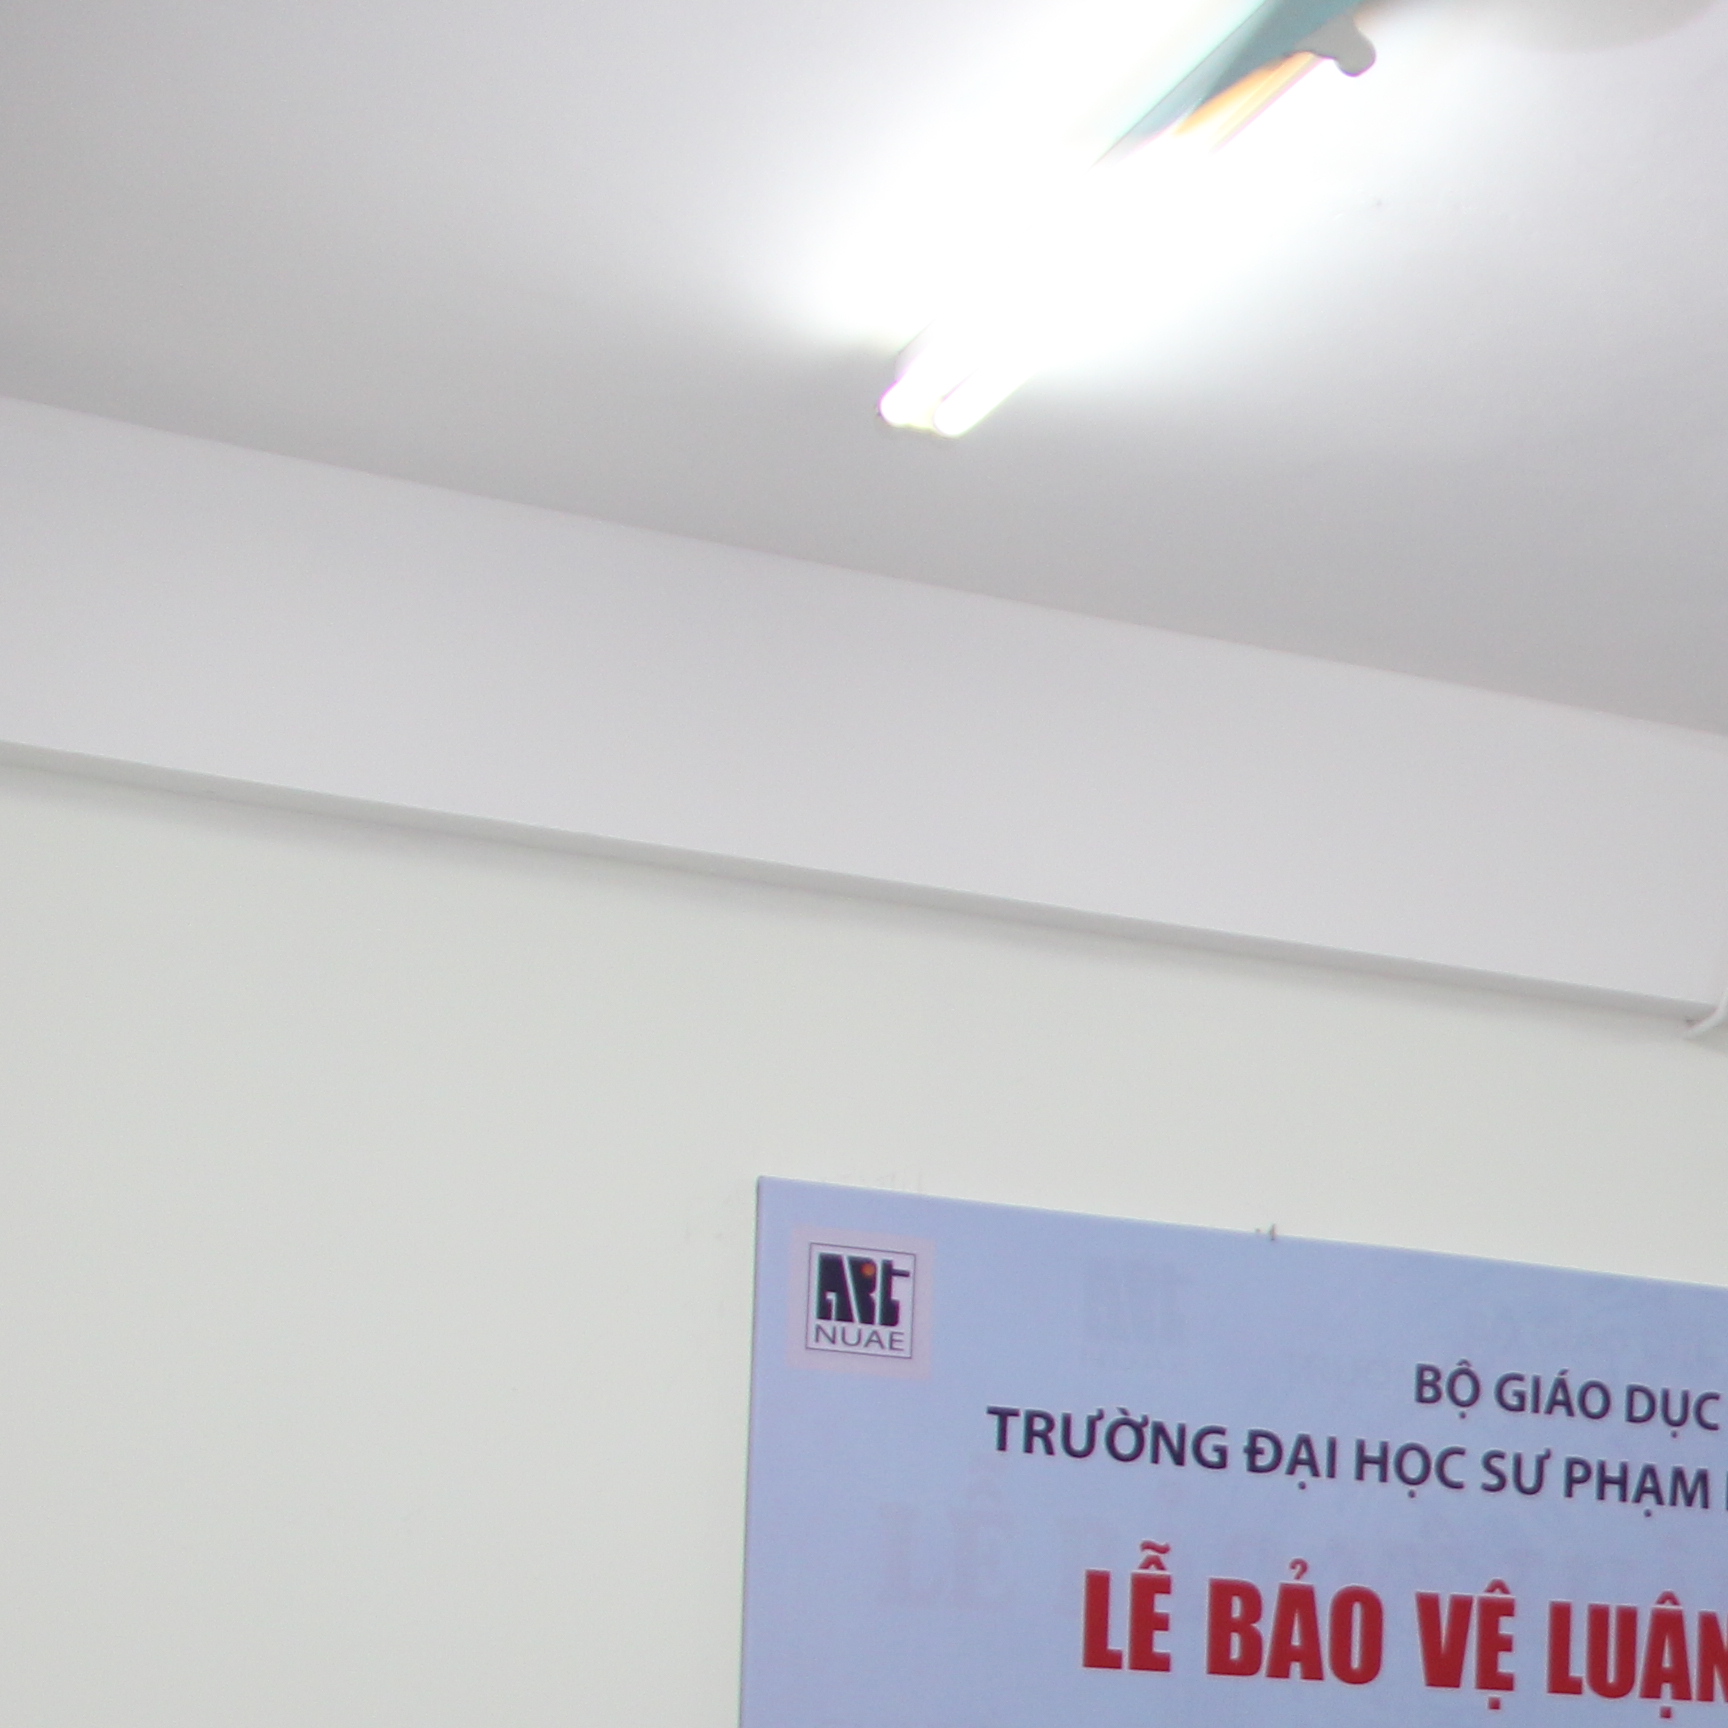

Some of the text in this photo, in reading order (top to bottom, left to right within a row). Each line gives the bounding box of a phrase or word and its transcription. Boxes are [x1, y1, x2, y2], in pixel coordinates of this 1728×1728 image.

[814, 1323, 905, 1352] NUAE
[1414, 1359, 1482, 1419] BỘ
[1495, 1370, 1611, 1420] GIÁO
[1626, 1385, 1720, 1438] DỤC
[987, 1407, 1228, 1470] TRƯỜNG
[1244, 1430, 1336, 1489] ĐẠI
[1355, 1440, 1465, 1498] HỌC
[1482, 1449, 1551, 1496] SƯ
[1565, 1458, 1709, 1517] PHẠM
[1083, 1540, 1173, 1673] LỄ
[1207, 1558, 1384, 1686] BẢO
[1416, 1578, 1516, 1711] VỆ
